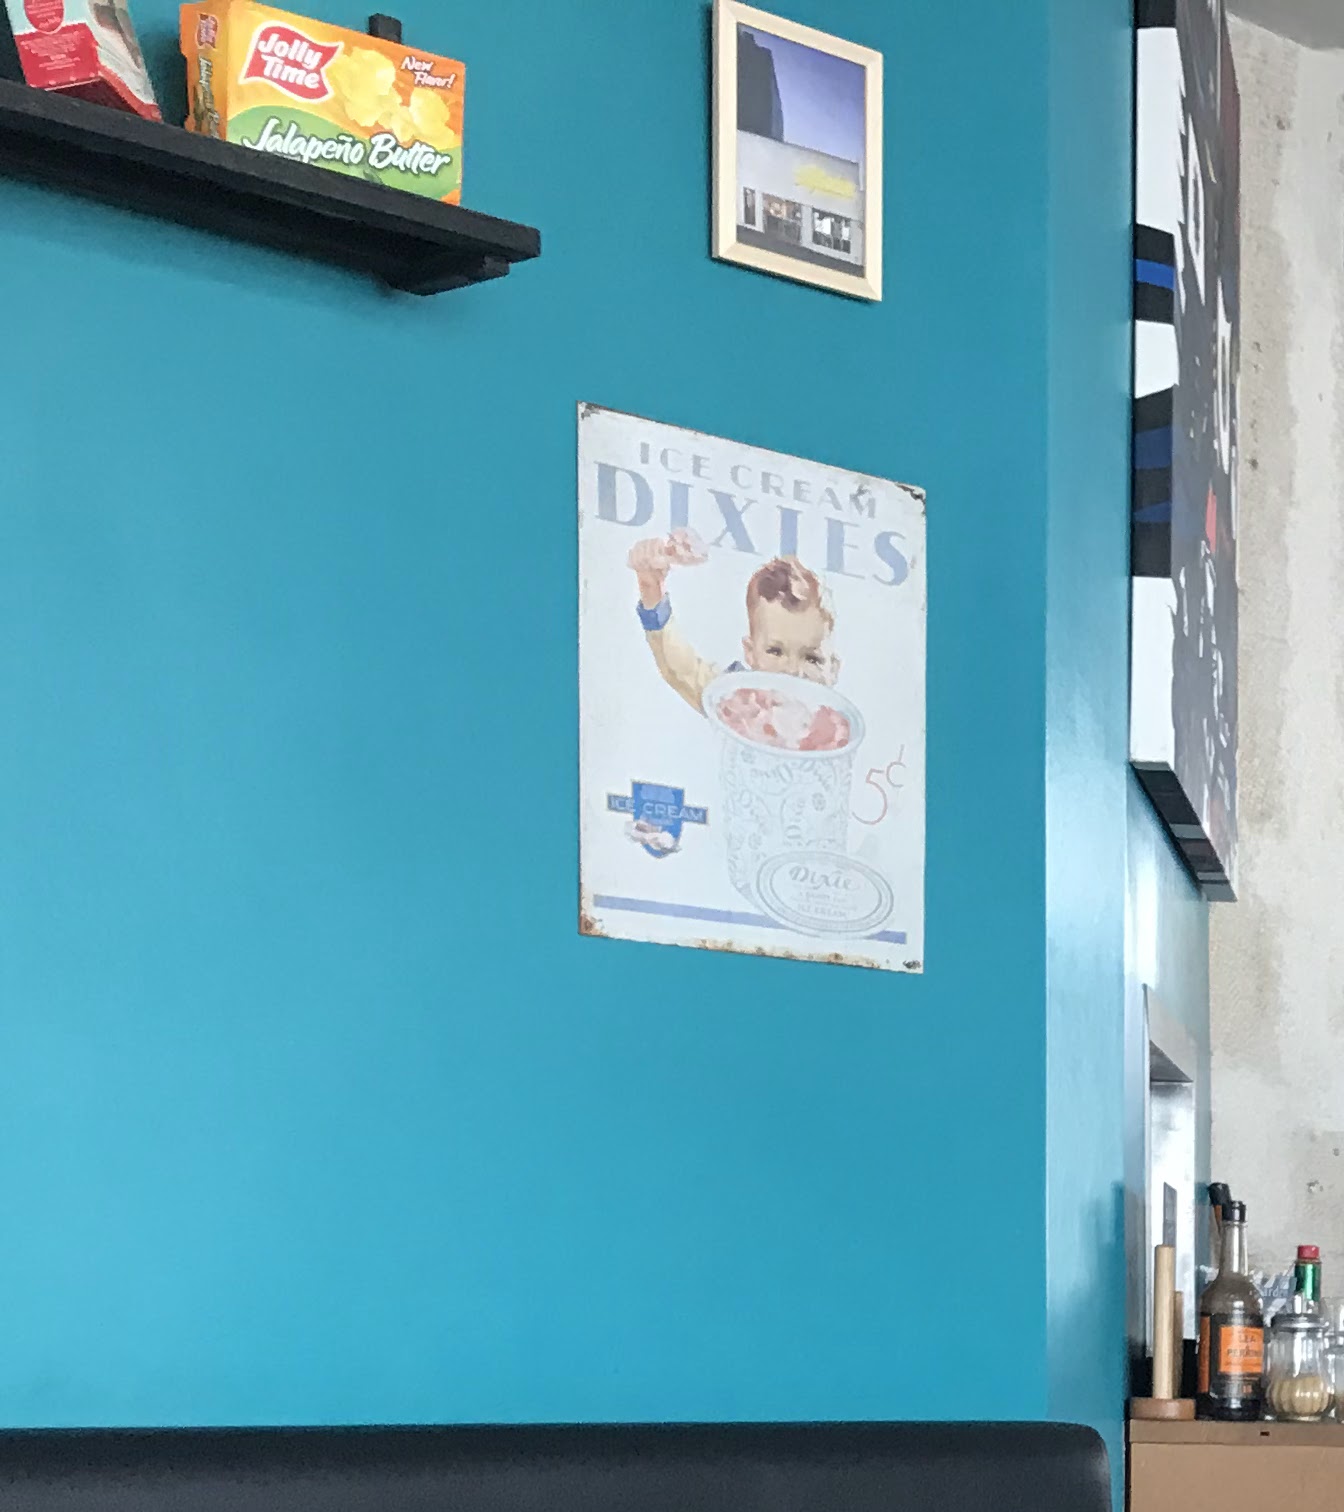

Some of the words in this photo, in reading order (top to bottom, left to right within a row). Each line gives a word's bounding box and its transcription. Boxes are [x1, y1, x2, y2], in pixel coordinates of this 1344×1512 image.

[258, 33, 323, 70] Jolly
[401, 57, 434, 72] New
[261, 54, 320, 89] Time
[414, 71, 456, 89] Flavor!
[243, 117, 365, 165] Jalapeño
[369, 133, 451, 175] Butter
[639, 441, 712, 481] ICE
[729, 464, 877, 519] CREAM
[593, 460, 910, 587] DIXIES
[642, 801, 704, 821] CREAM
